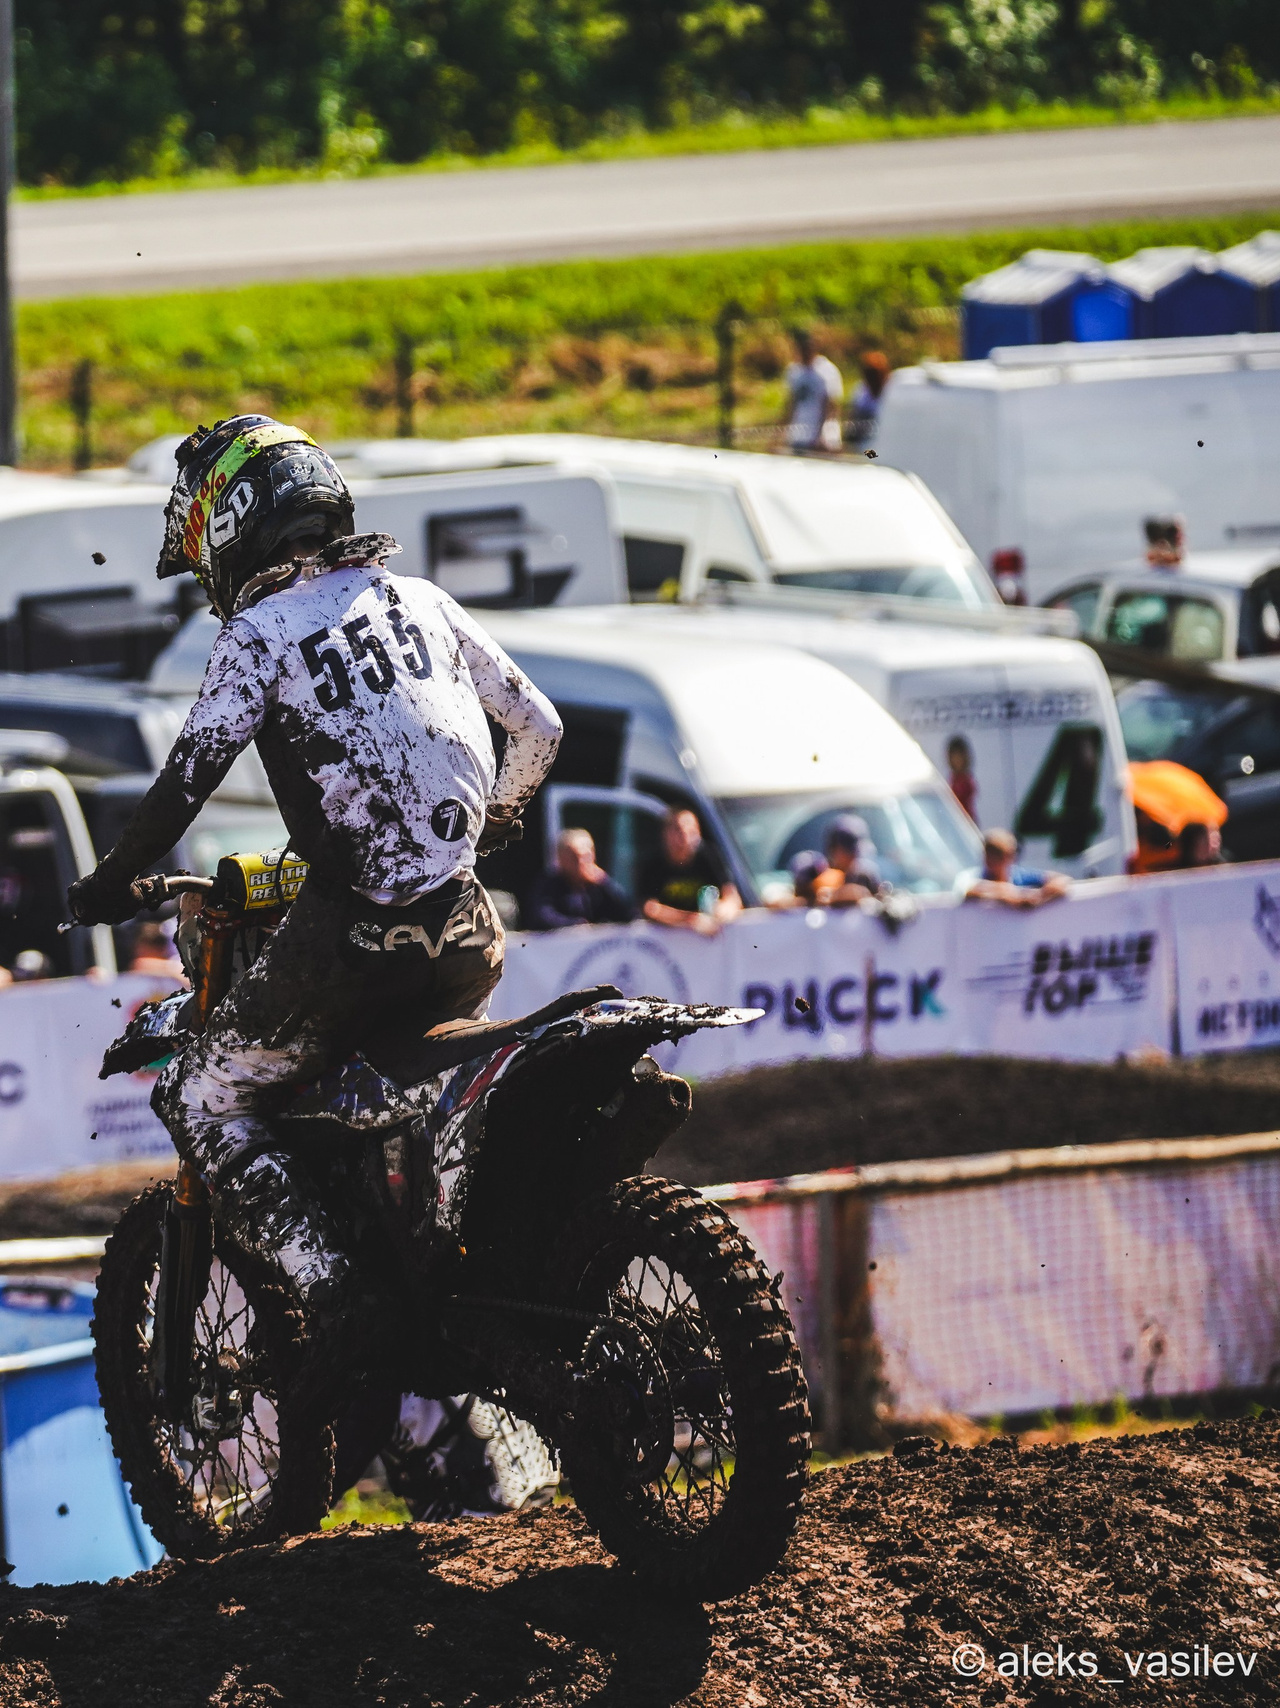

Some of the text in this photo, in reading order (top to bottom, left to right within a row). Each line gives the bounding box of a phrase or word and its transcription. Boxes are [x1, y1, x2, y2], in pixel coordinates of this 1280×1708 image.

[298, 607, 433, 713] 555
[439, 803, 461, 841] 7
[1015, 721, 1105, 859] 4
